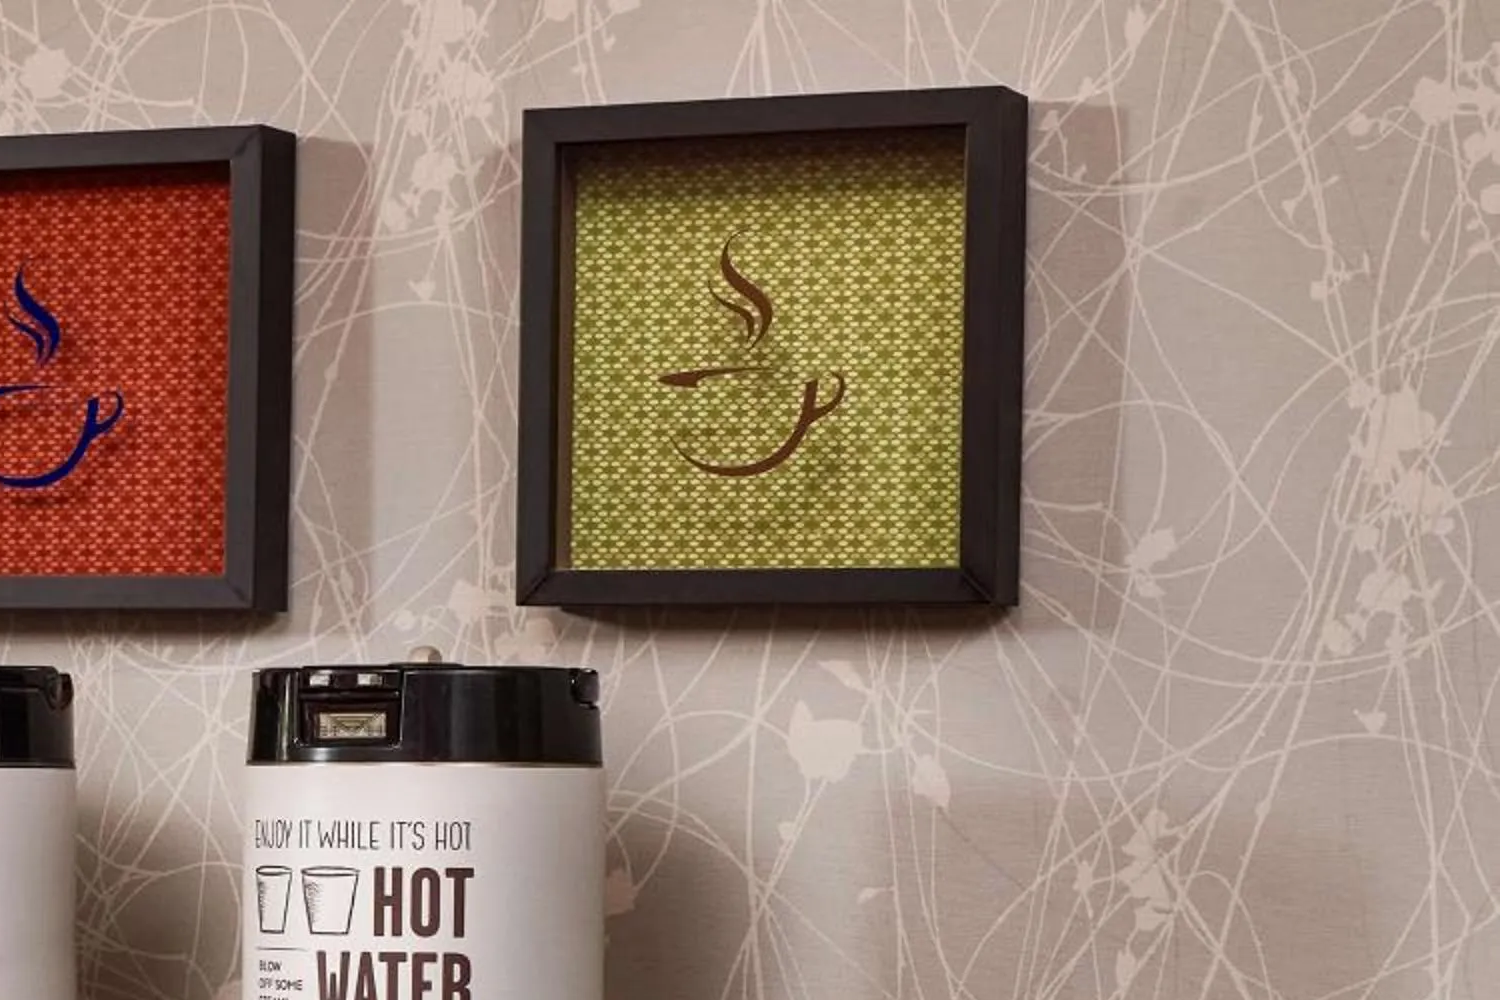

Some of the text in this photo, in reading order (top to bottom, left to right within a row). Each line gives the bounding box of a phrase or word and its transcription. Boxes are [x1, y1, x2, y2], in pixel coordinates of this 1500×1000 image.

[255, 819, 472, 851] ENJOY IT WHILE IT'S HOT
[373, 866, 475, 939] HOT
